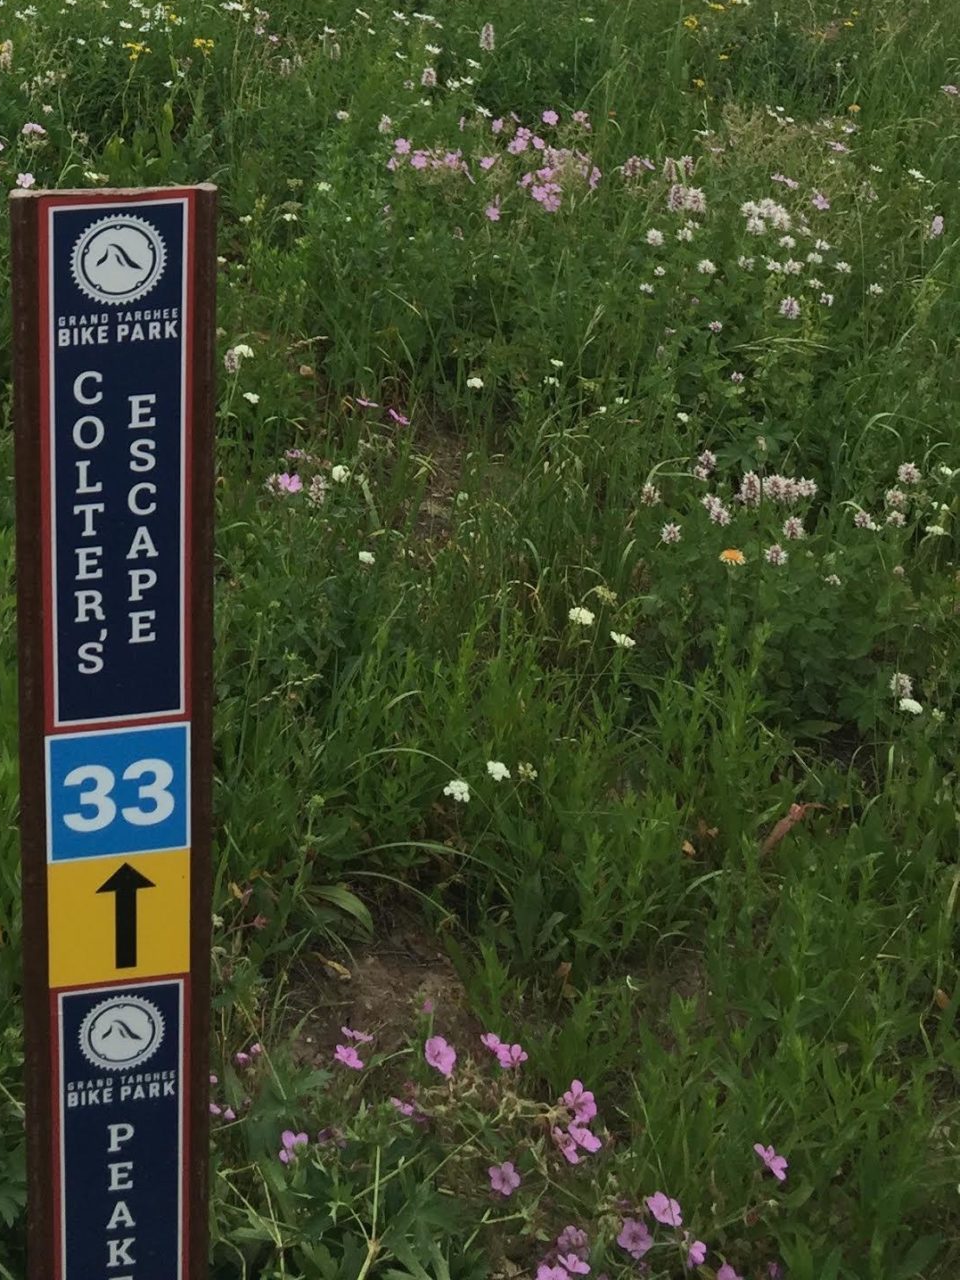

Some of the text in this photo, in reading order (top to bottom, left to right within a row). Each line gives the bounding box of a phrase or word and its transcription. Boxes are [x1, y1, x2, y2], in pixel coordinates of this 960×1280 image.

[58, 308, 179, 327] GRAND TARGHEE
[58, 320, 179, 347] BIKE PARK
[72, 370, 108, 675] COLTER'S
[126, 393, 159, 644] ESCAPE
[63, 758, 175, 833] 33
[67, 1077, 114, 1091] GRAND
[67, 1080, 176, 1108] BIKE PARK
[106, 1123, 137, 1280] PEAK
